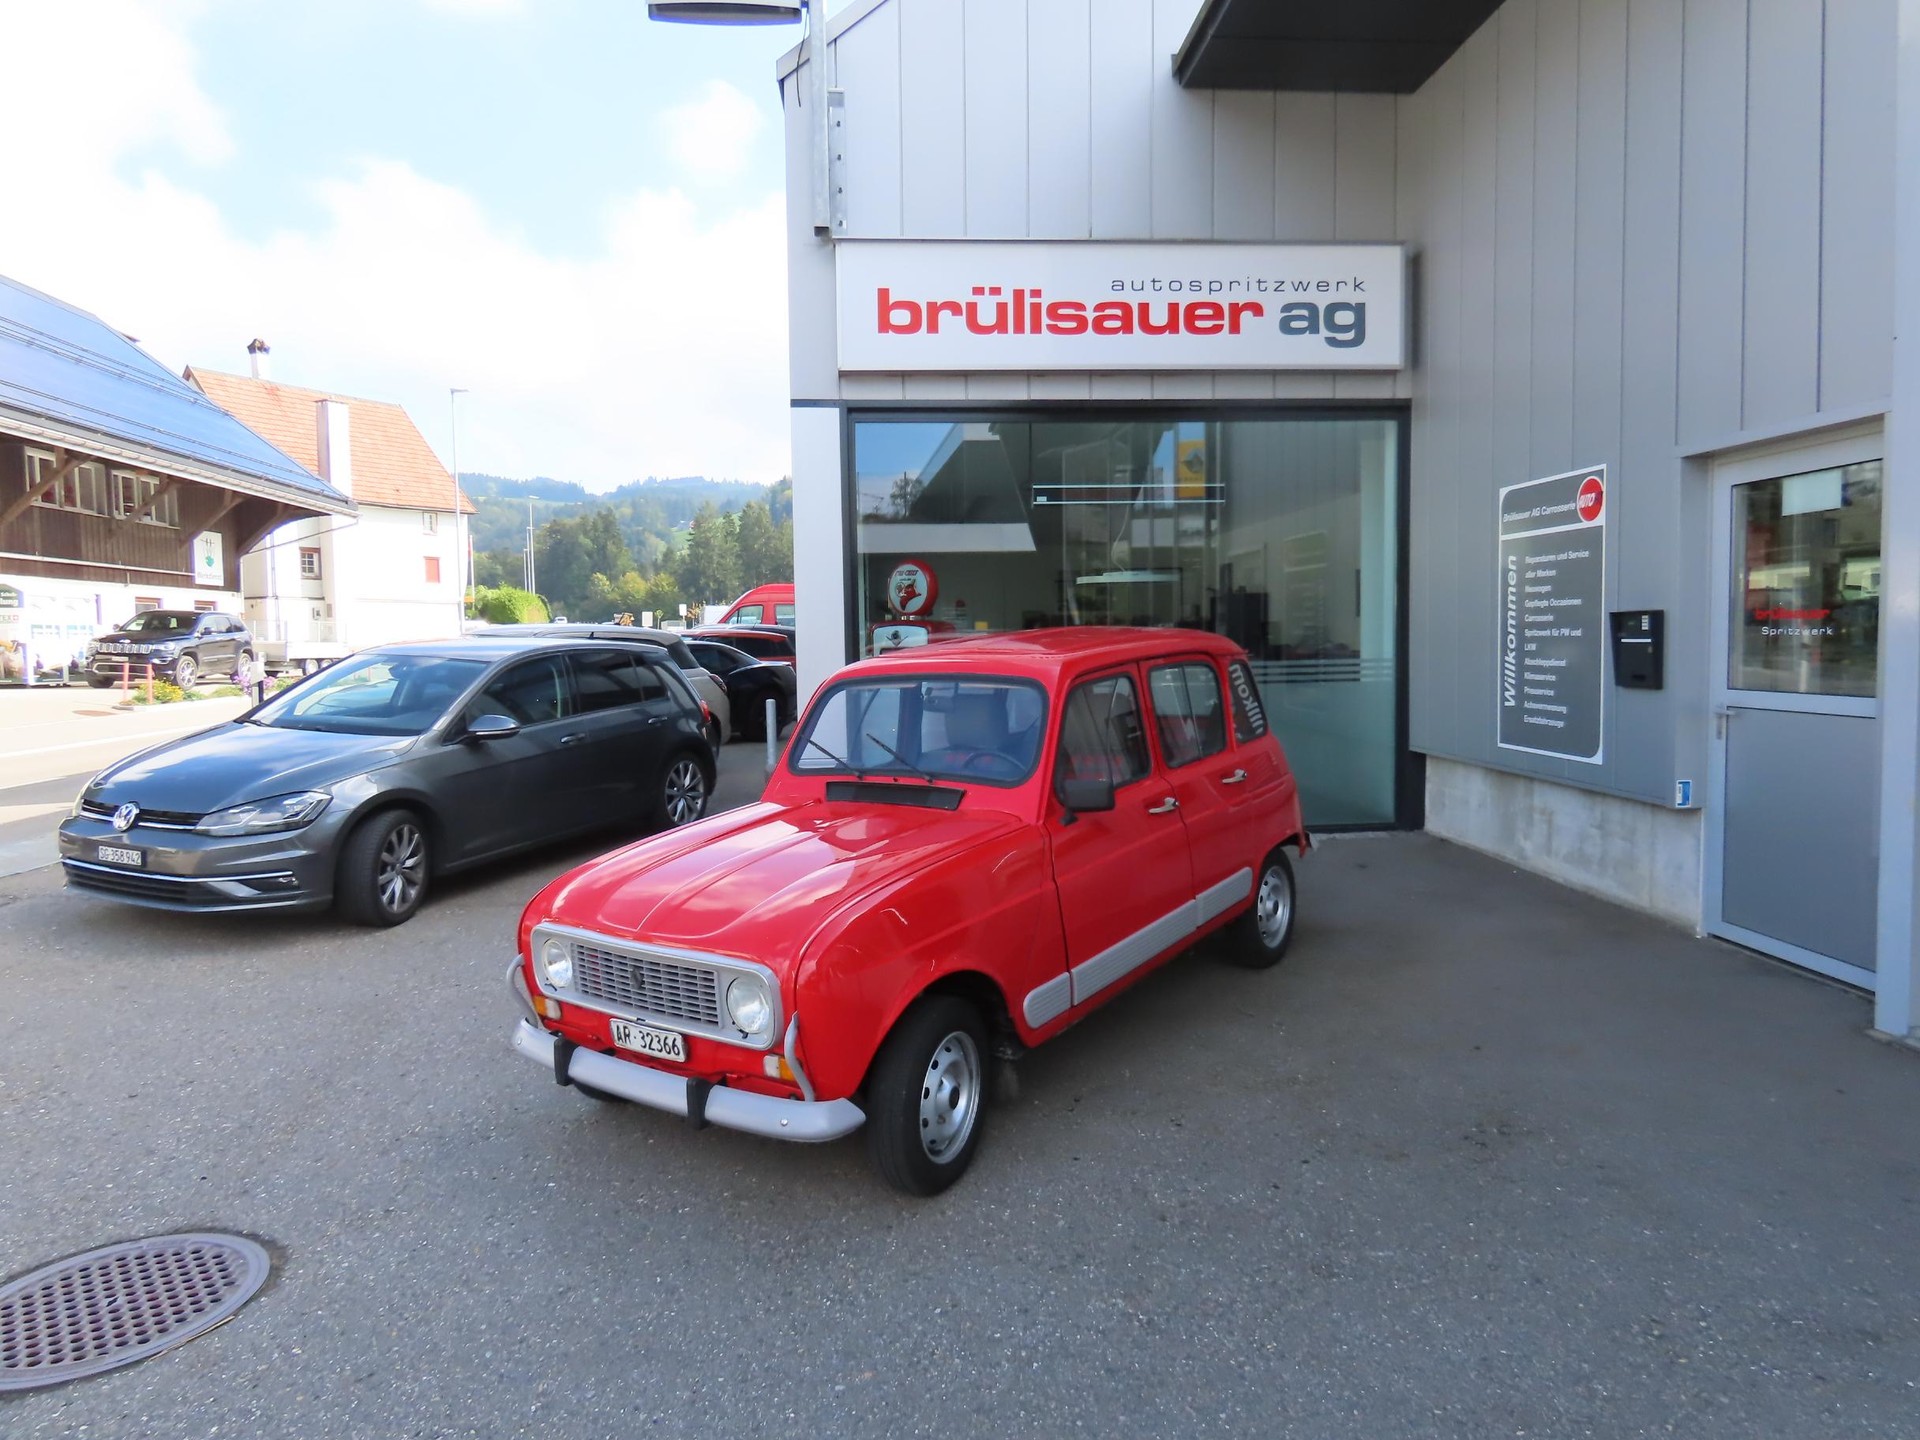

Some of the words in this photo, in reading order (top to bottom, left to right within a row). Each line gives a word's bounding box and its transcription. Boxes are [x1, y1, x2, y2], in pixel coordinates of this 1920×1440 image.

[1111, 276, 1366, 295] autospritzwerk
[877, 286, 1264, 335] brülisauer
[1278, 301, 1366, 349] ag
[1531, 507, 1541, 518] AG
[1568, 549, 1589, 559] Service
[1504, 555, 1517, 707] Willkommen
[1761, 626, 1834, 636] Spritzwerk
